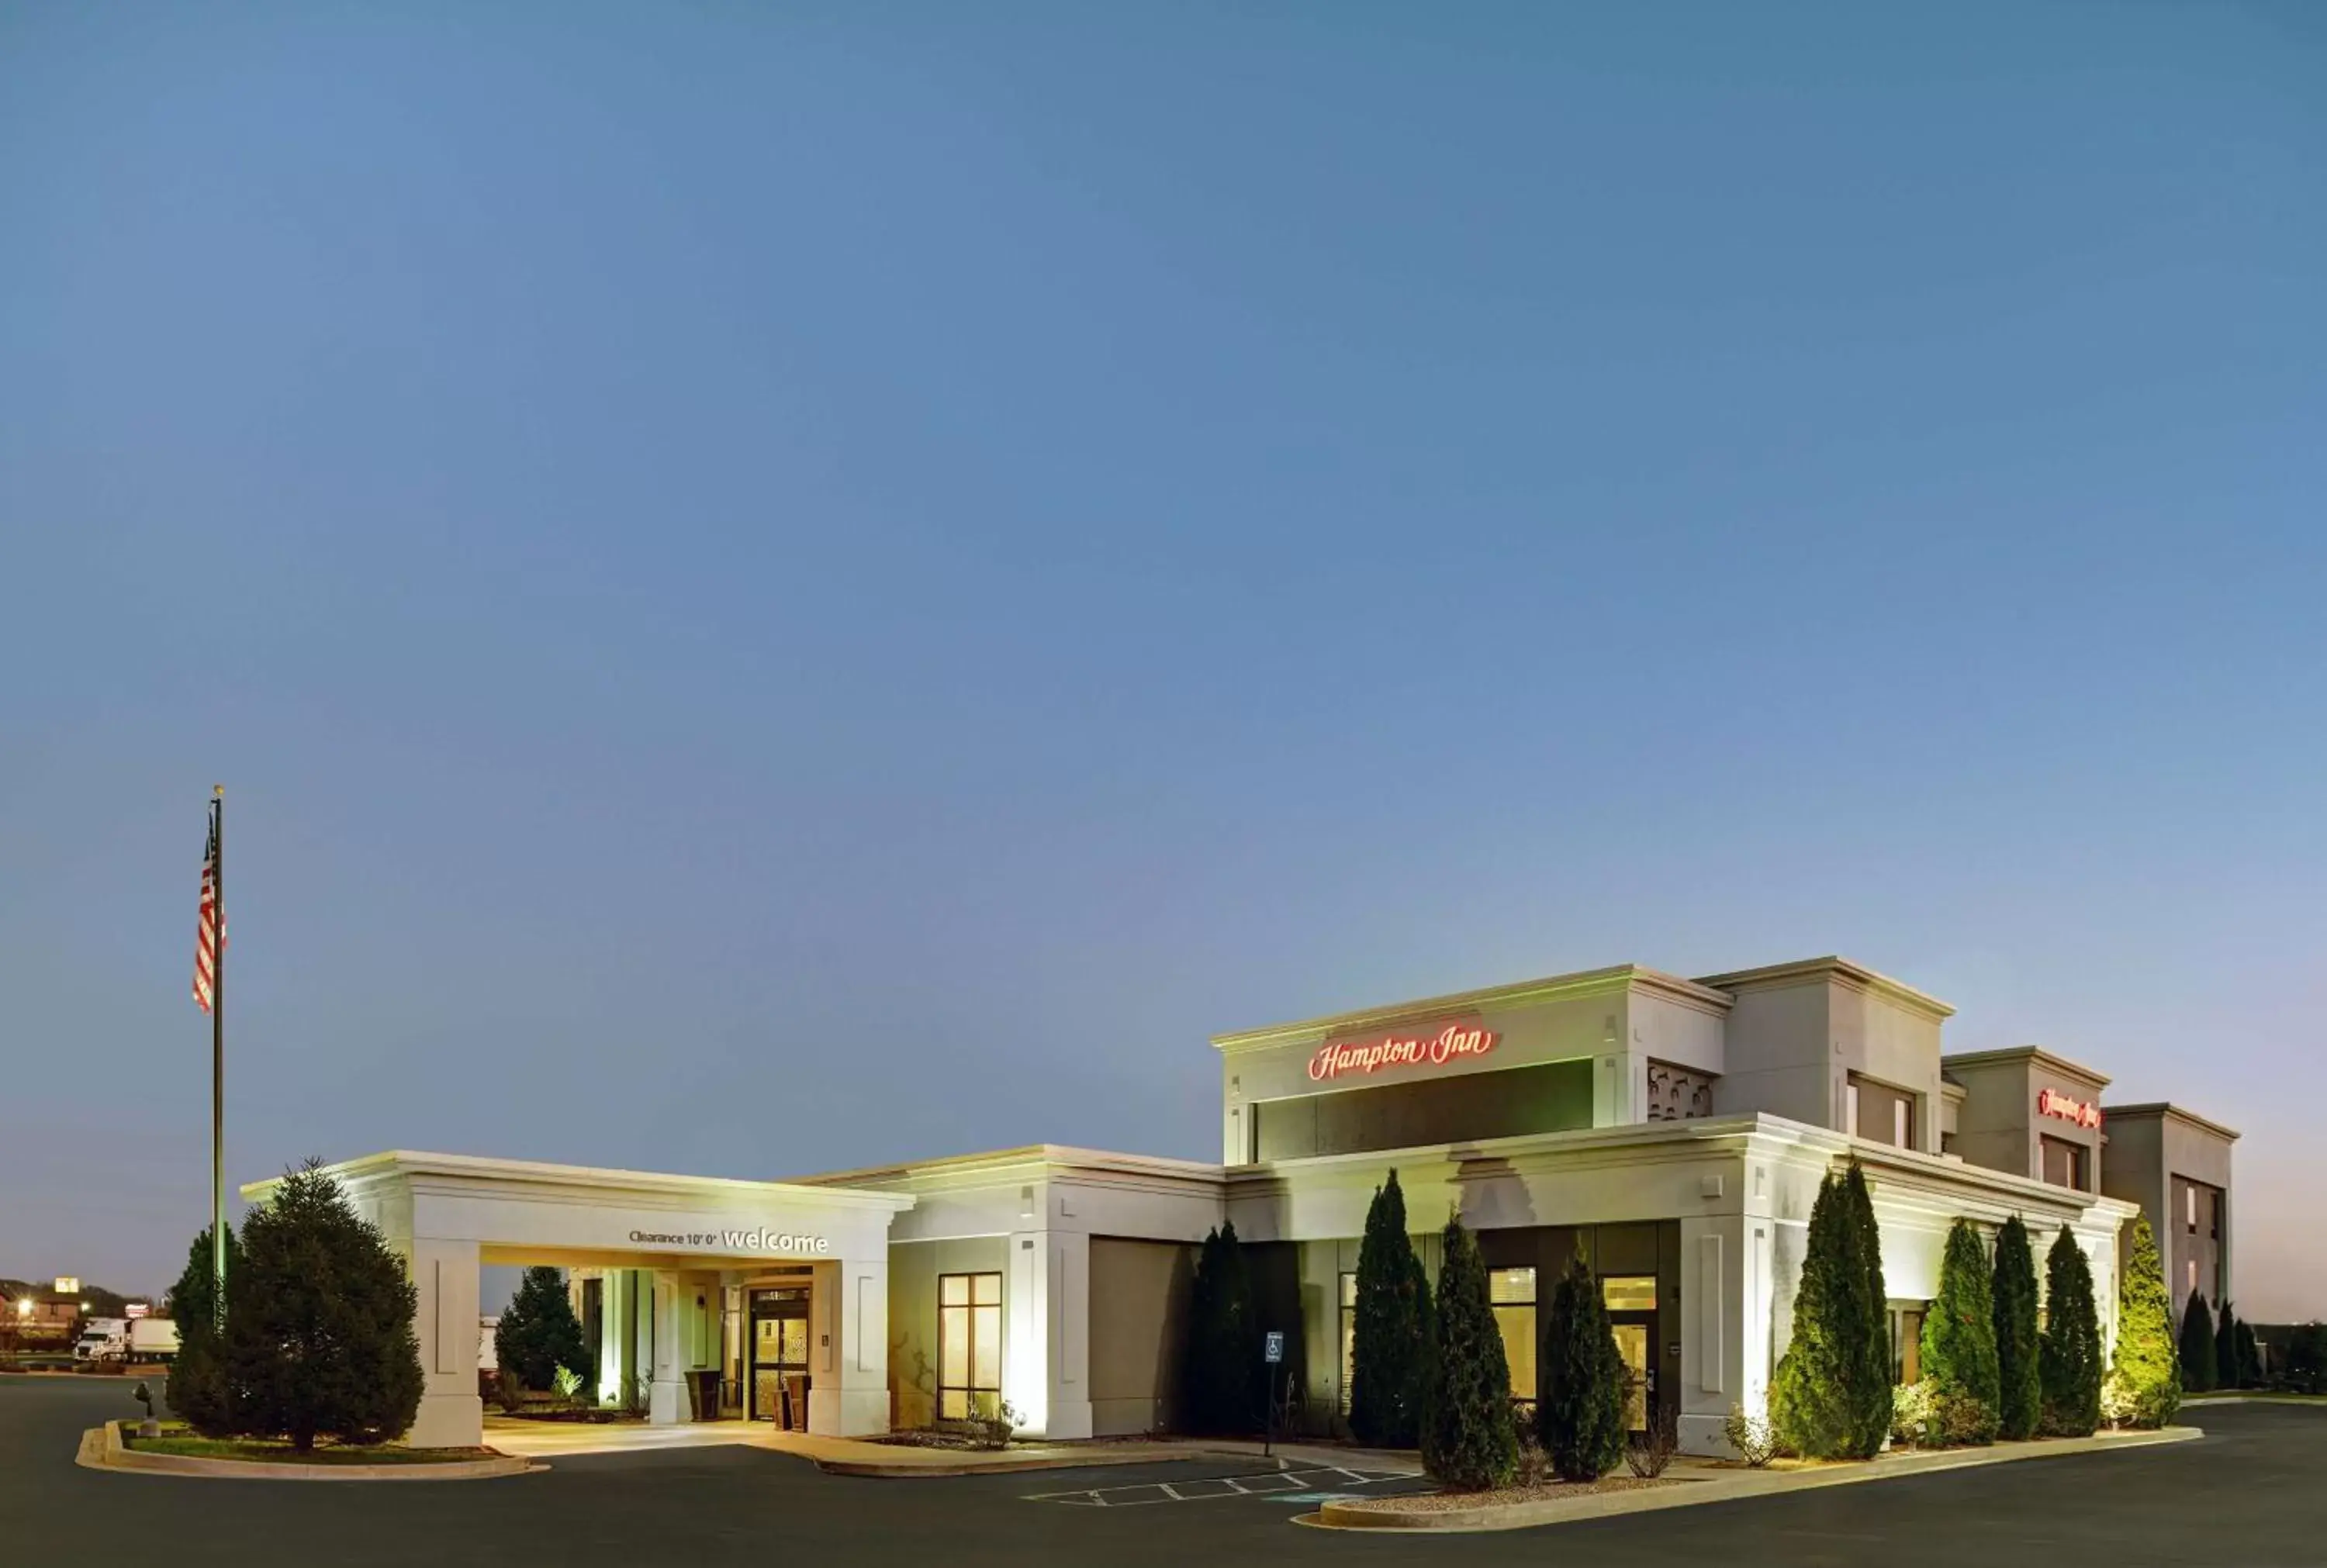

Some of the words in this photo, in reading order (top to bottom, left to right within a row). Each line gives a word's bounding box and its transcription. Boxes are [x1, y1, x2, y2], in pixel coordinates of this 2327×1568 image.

[1309, 1038, 1426, 1080] Hampton
[1430, 1026, 1492, 1063] Inn
[629, 1230, 684, 1244] Clearance
[721, 1226, 829, 1252] welcome
